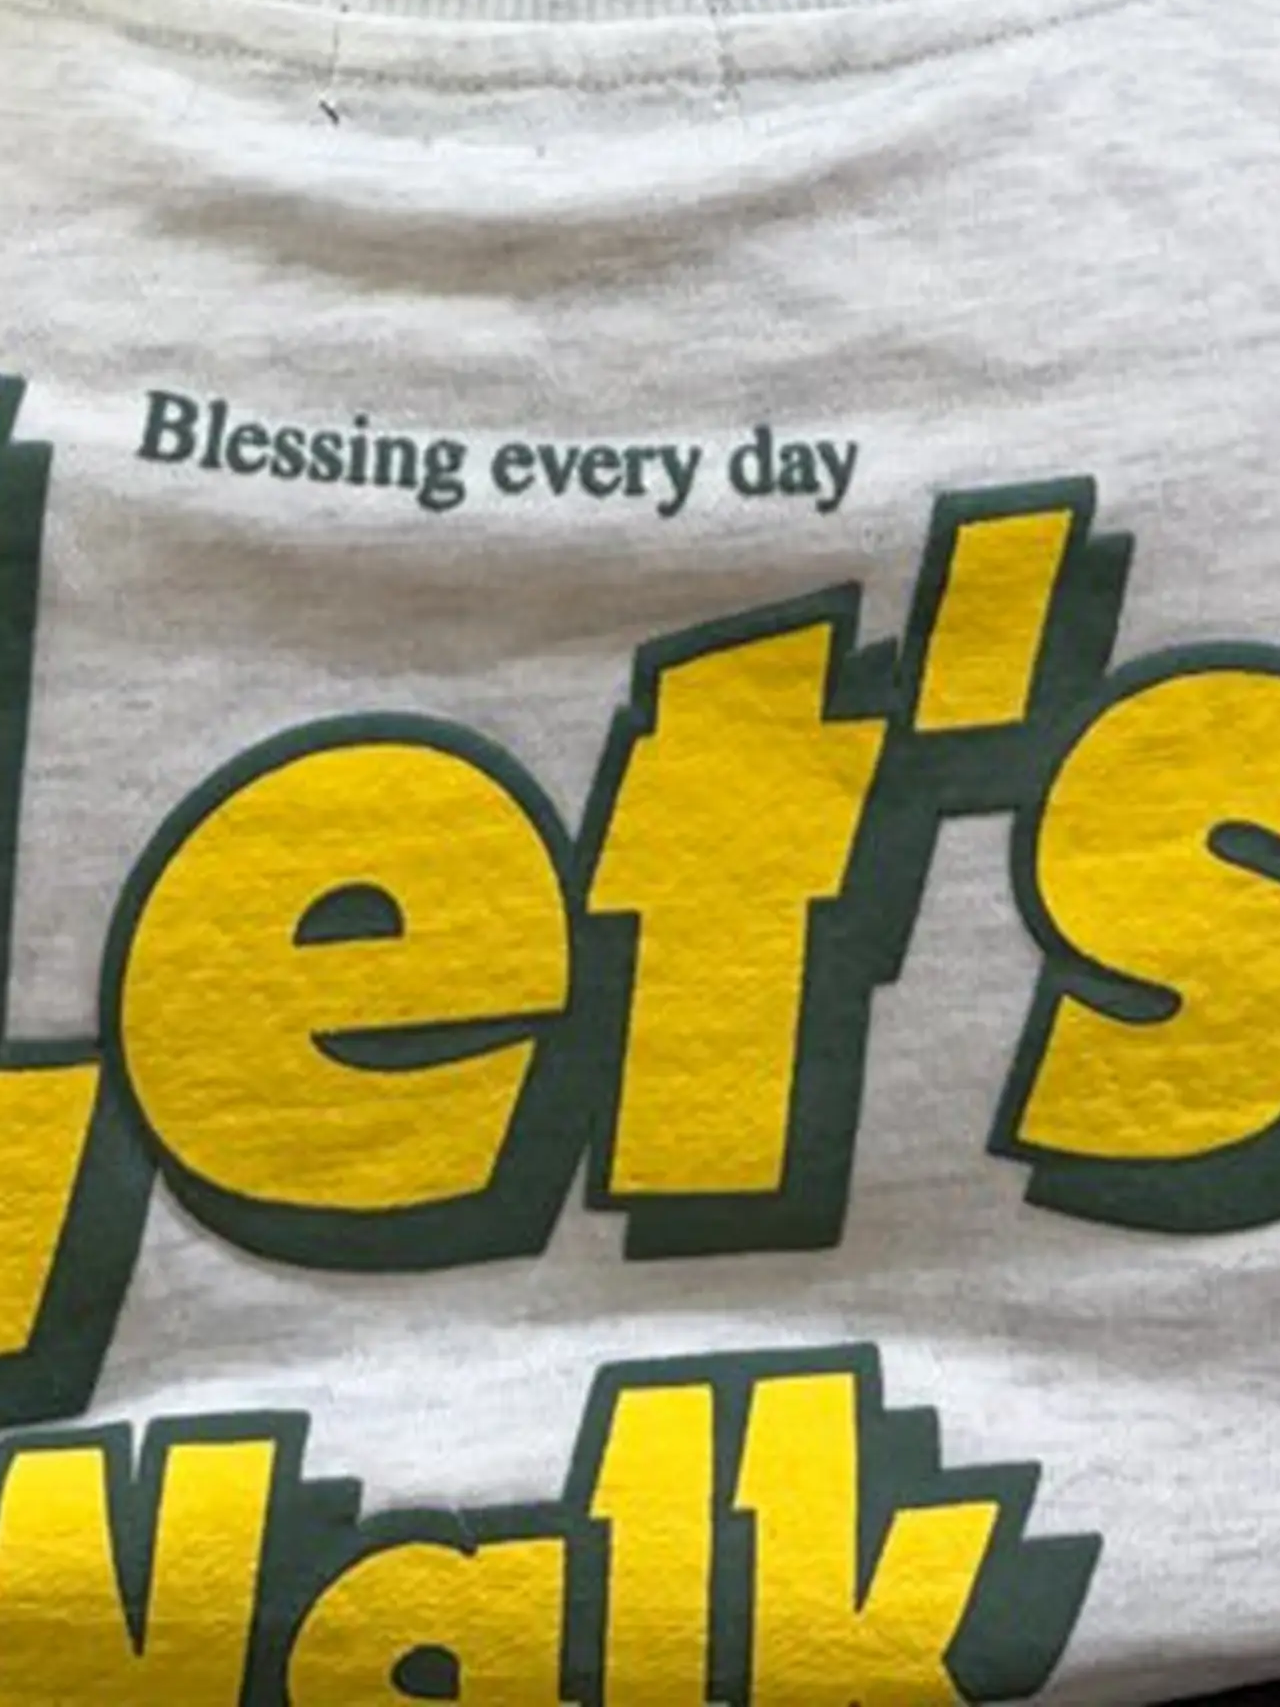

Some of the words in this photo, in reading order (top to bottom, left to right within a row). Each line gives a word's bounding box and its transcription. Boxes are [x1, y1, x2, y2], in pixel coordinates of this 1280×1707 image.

[136, 388, 467, 515] Blessing
[490, 437, 702, 521] every
[728, 423, 860, 516] day
